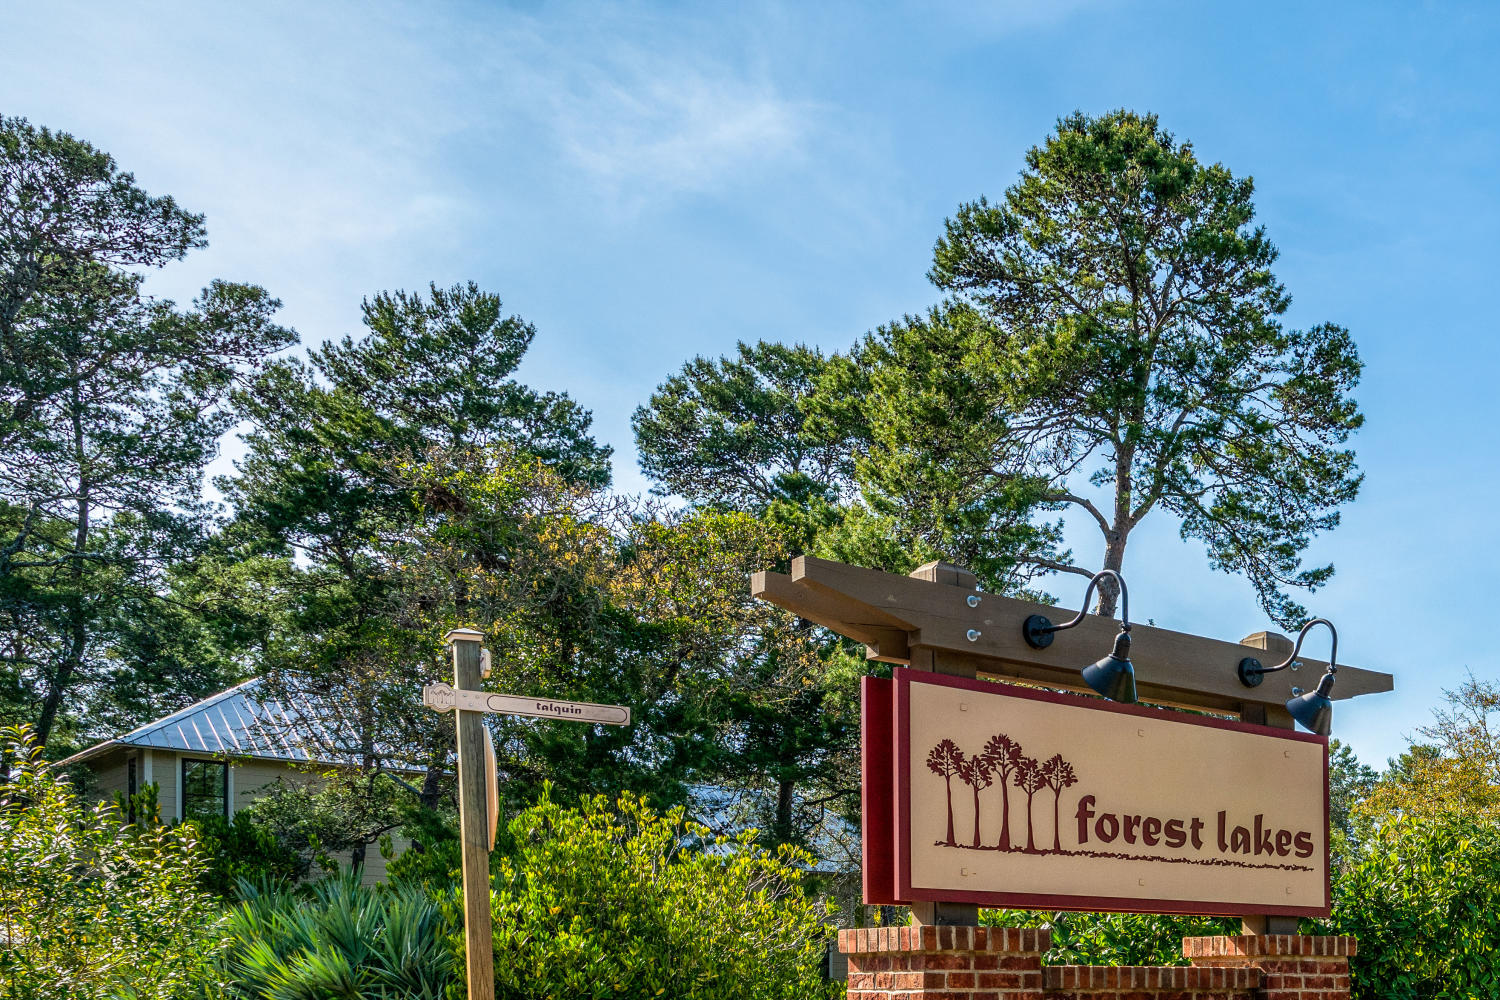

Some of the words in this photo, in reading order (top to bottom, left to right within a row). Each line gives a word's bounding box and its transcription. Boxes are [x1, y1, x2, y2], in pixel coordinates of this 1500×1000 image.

[537, 703, 581, 714] talquin
[1075, 795, 1204, 849] forest
[1217, 811, 1314, 858] lakes
